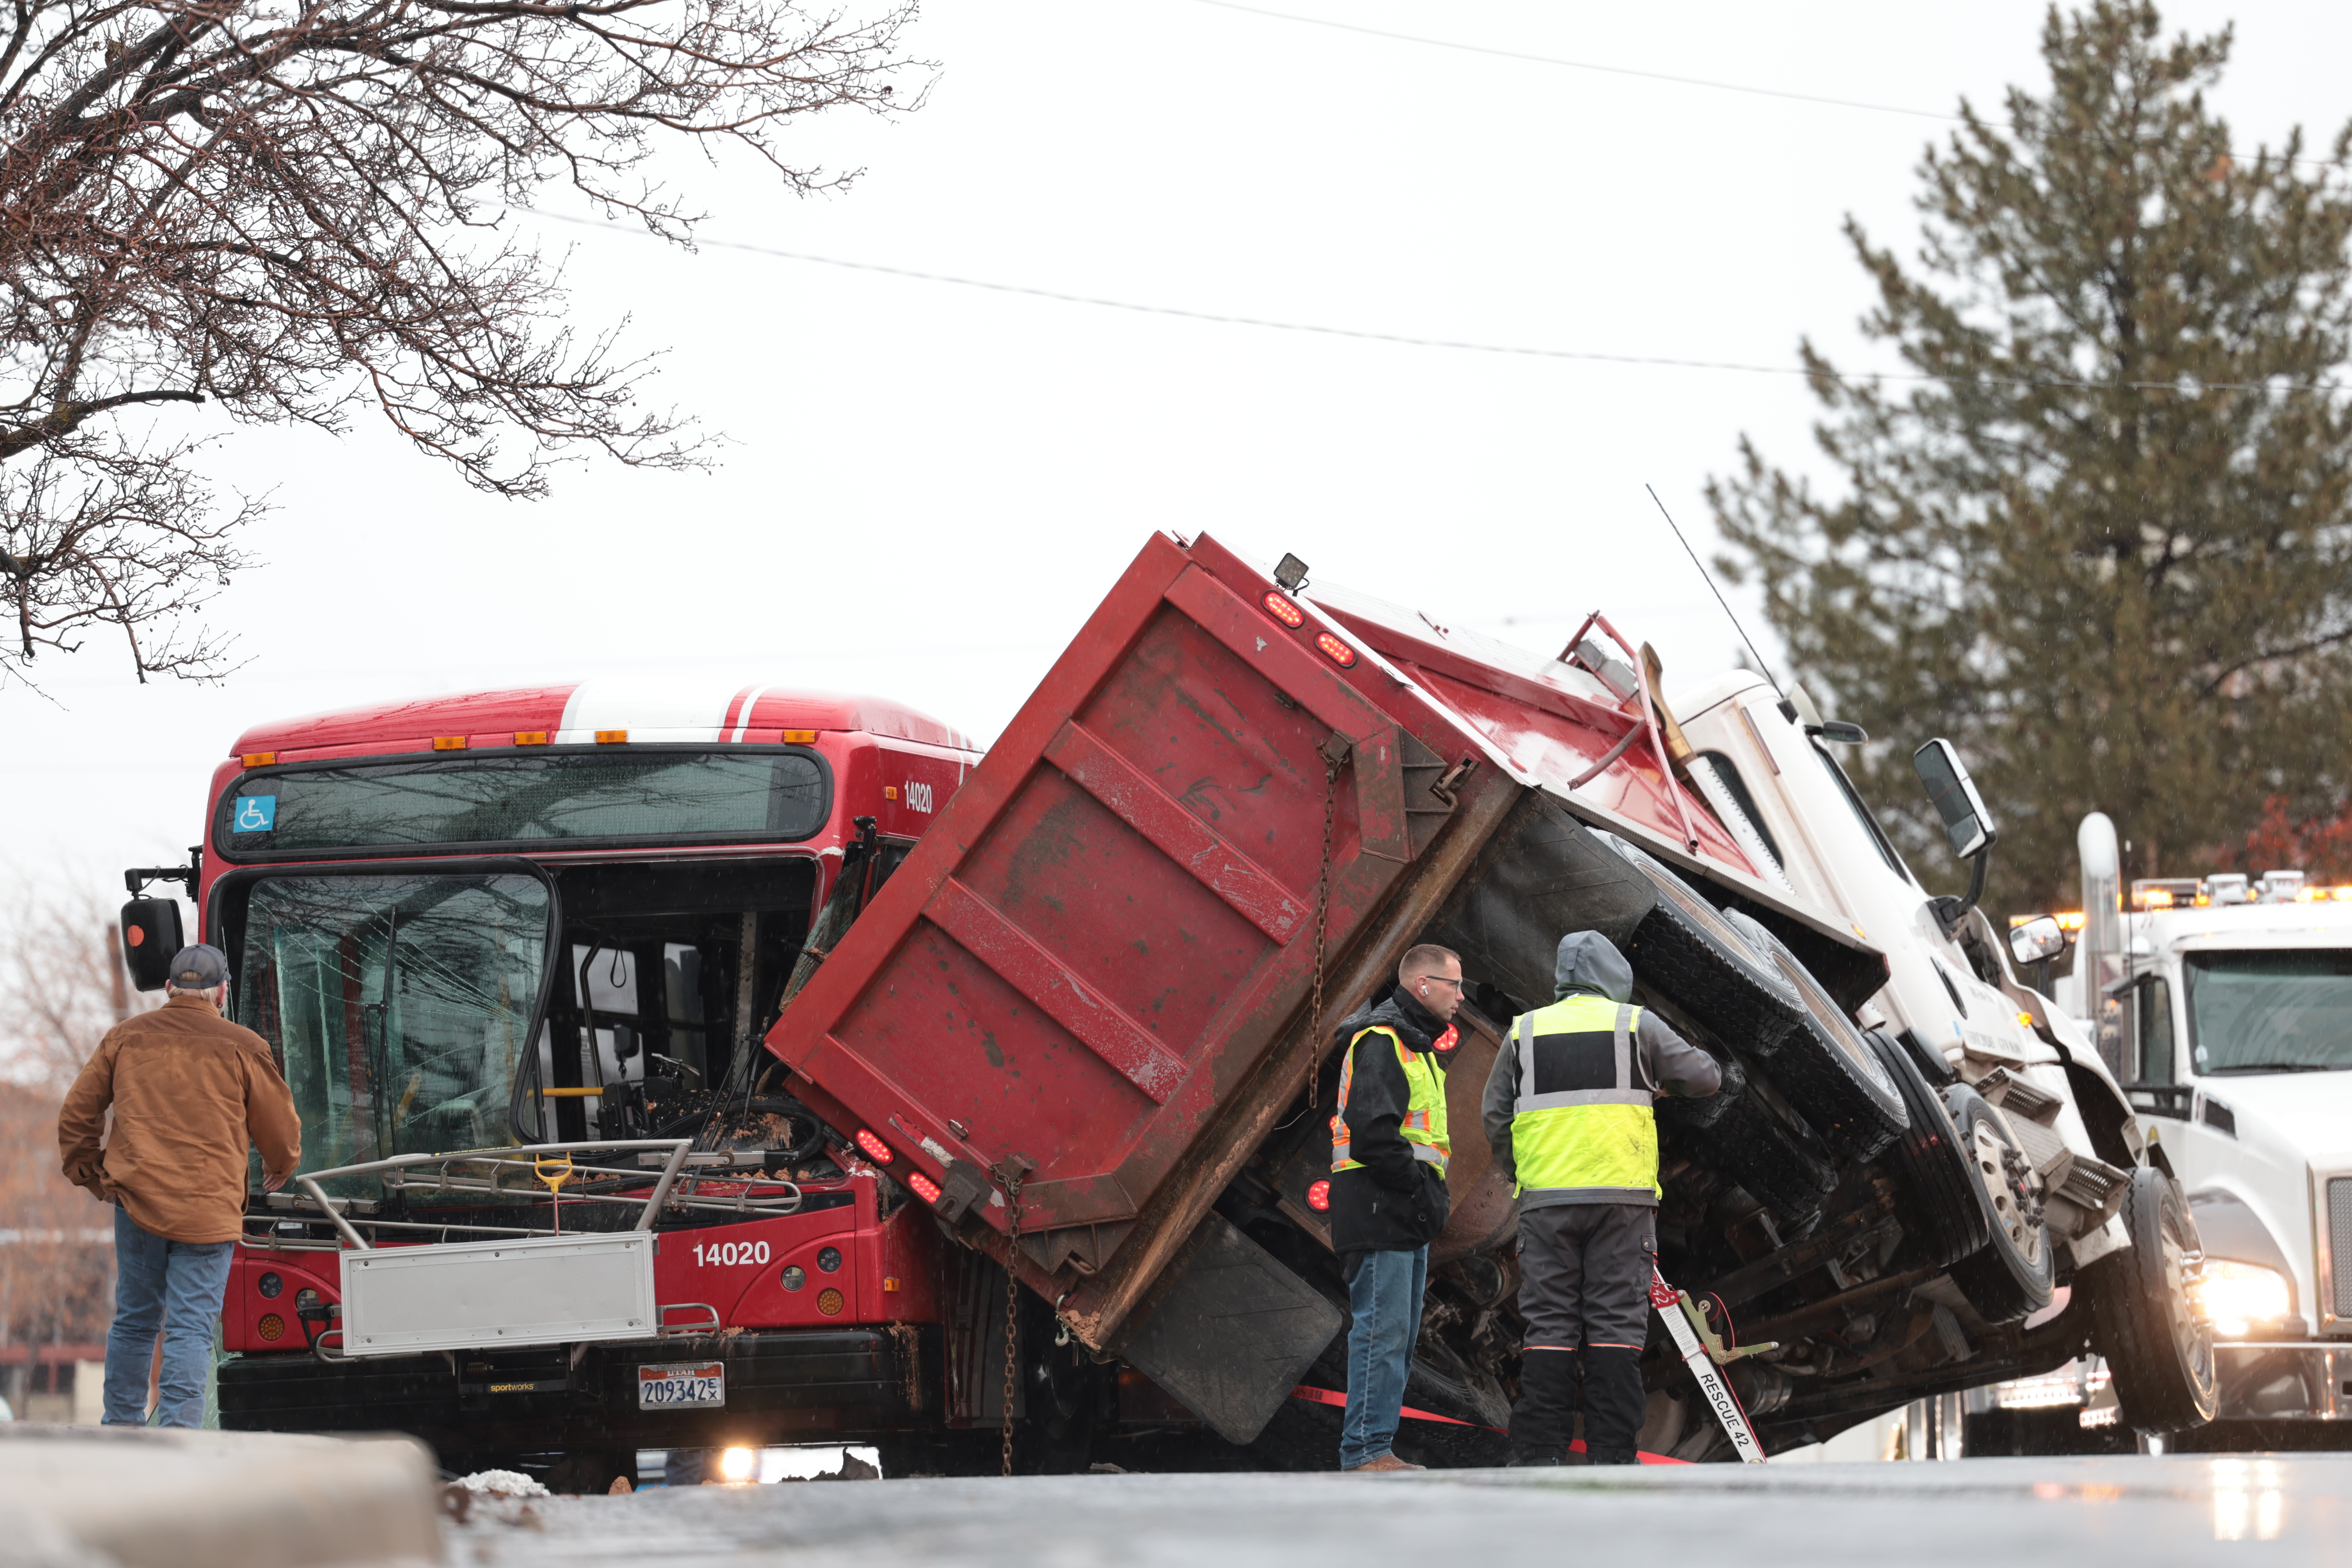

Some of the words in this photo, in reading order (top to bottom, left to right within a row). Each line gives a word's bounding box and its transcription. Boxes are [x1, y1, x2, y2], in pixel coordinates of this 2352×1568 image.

[904, 780, 932, 814] 14020
[693, 1241, 770, 1267] 14020
[491, 1383, 534, 1392] sportworks
[644, 1380, 706, 1403] 209342
[1700, 1374, 1740, 1429] RESCUE
[1735, 1432, 1749, 1447] 42
